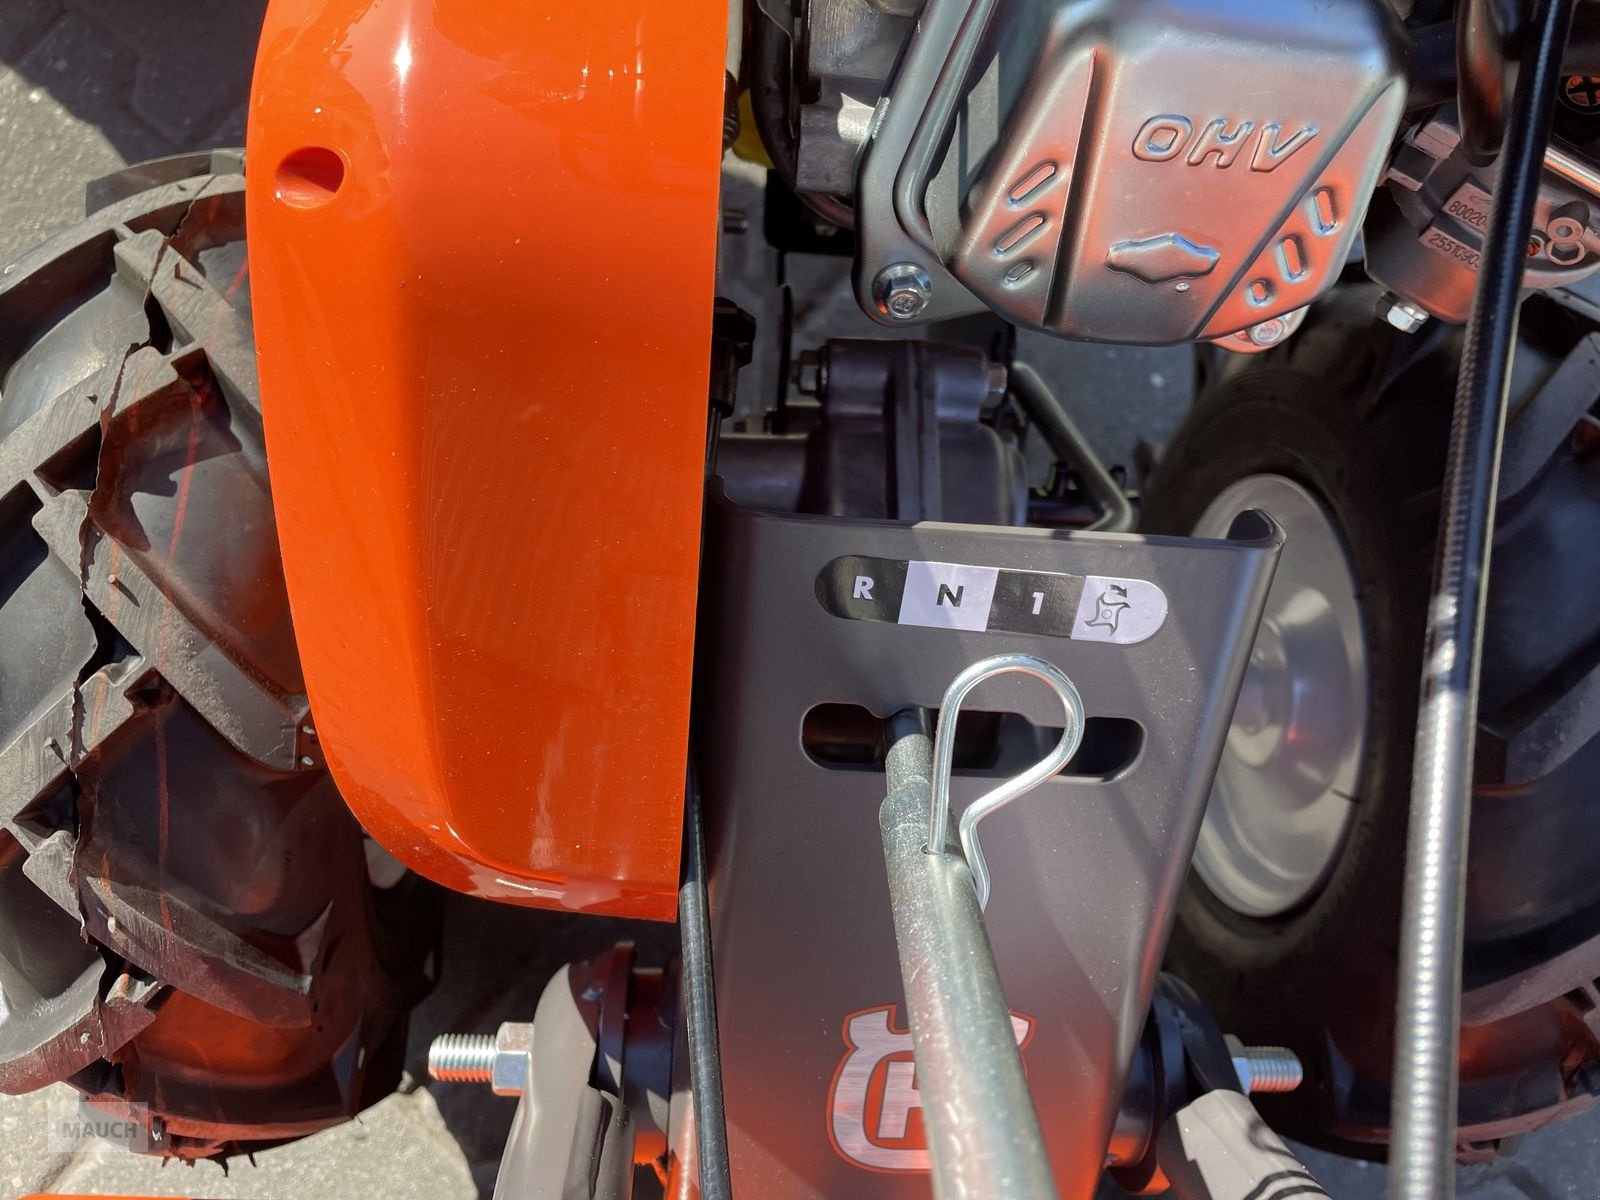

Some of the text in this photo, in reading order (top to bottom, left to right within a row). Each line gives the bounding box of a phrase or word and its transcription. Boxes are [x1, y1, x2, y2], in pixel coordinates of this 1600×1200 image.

[1131, 114, 1319, 173] OHV
[1448, 200, 1488, 227] 80020
[853, 575, 1045, 615] R N 1
